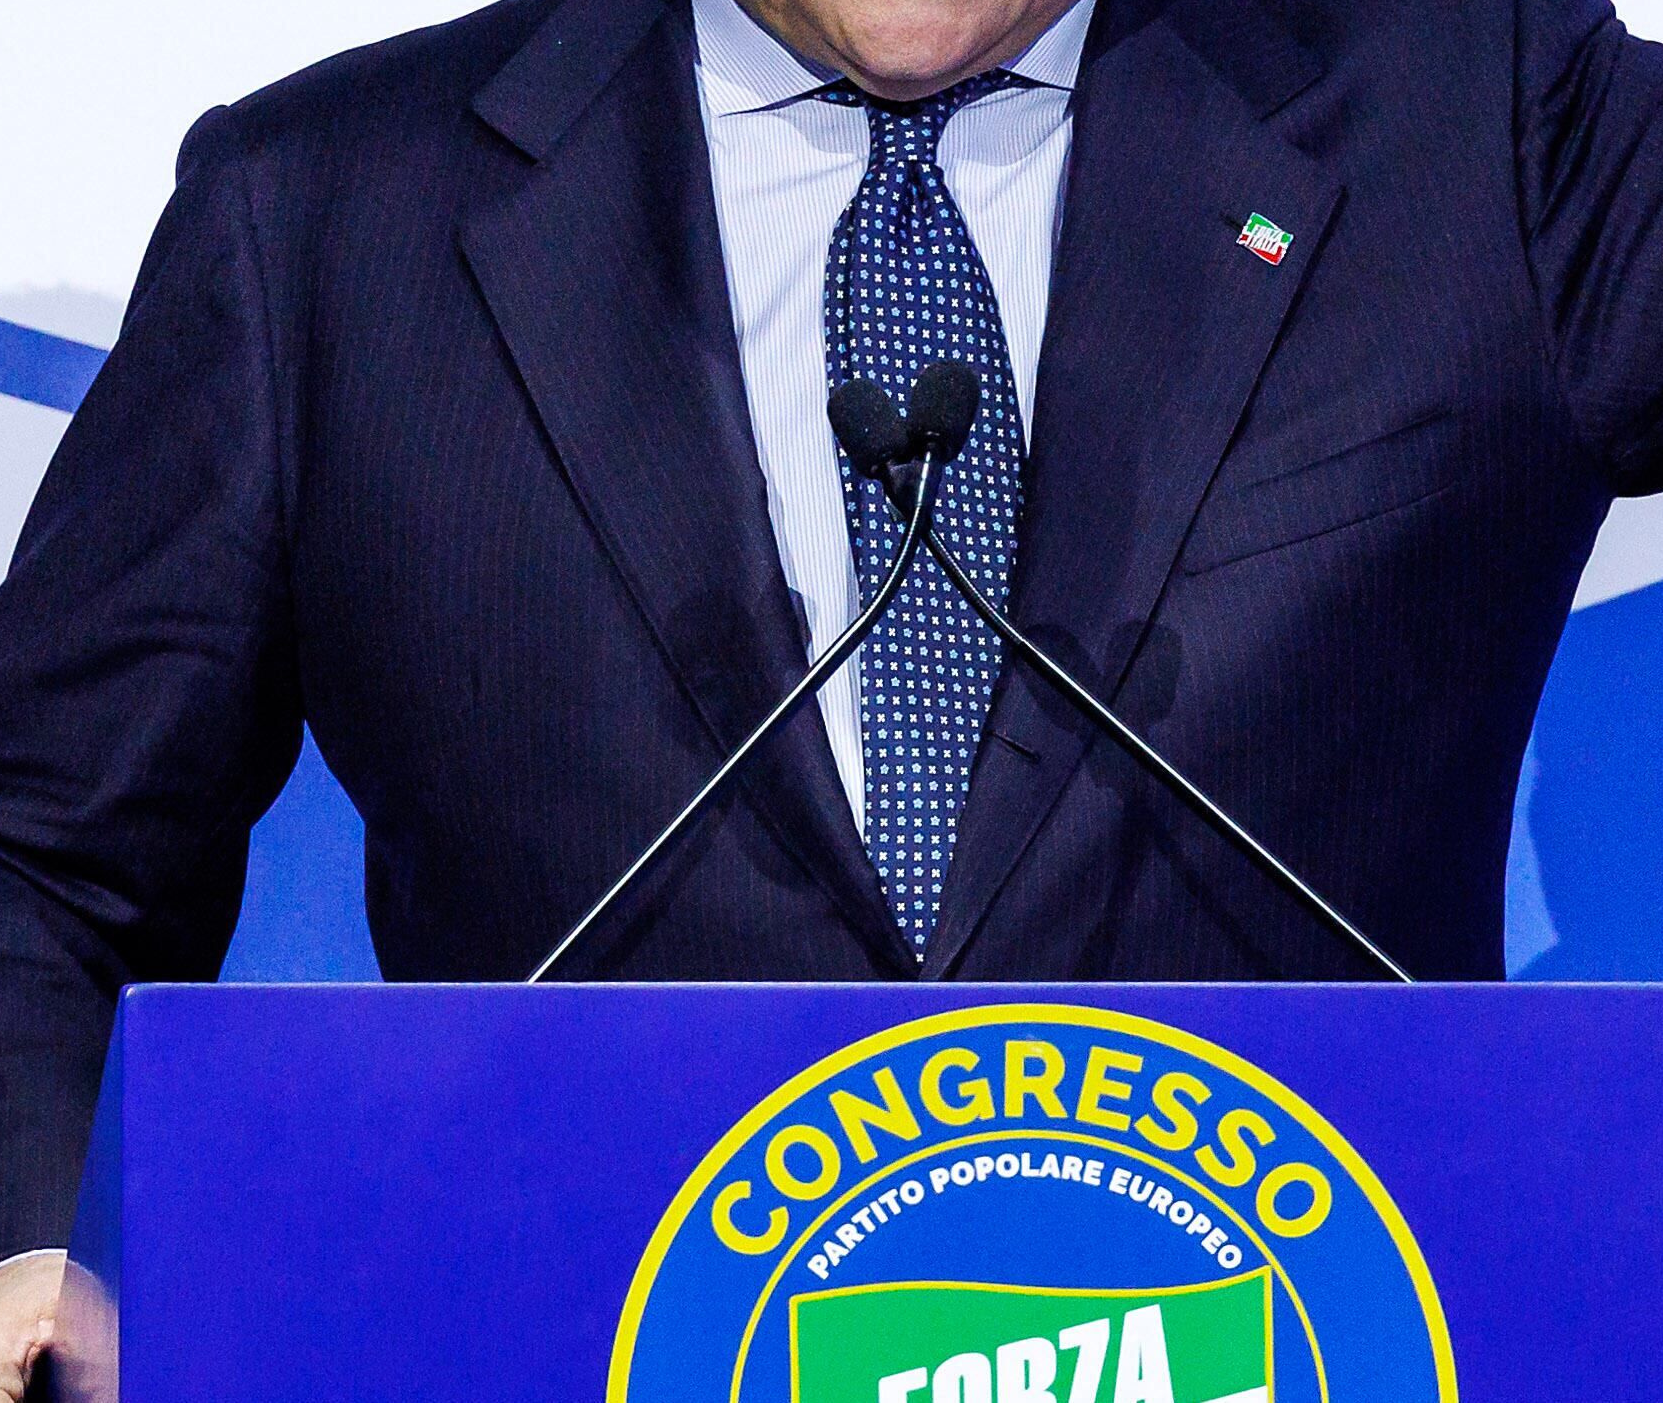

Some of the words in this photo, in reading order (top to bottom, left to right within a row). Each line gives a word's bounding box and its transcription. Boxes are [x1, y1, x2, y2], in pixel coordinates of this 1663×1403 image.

[712, 1041, 1331, 1255] CONGRESSO
[808, 1180, 925, 1280] PARTITO
[930, 1152, 1105, 1194] POPOLARE
[1108, 1167, 1242, 1269] EUROPEO
